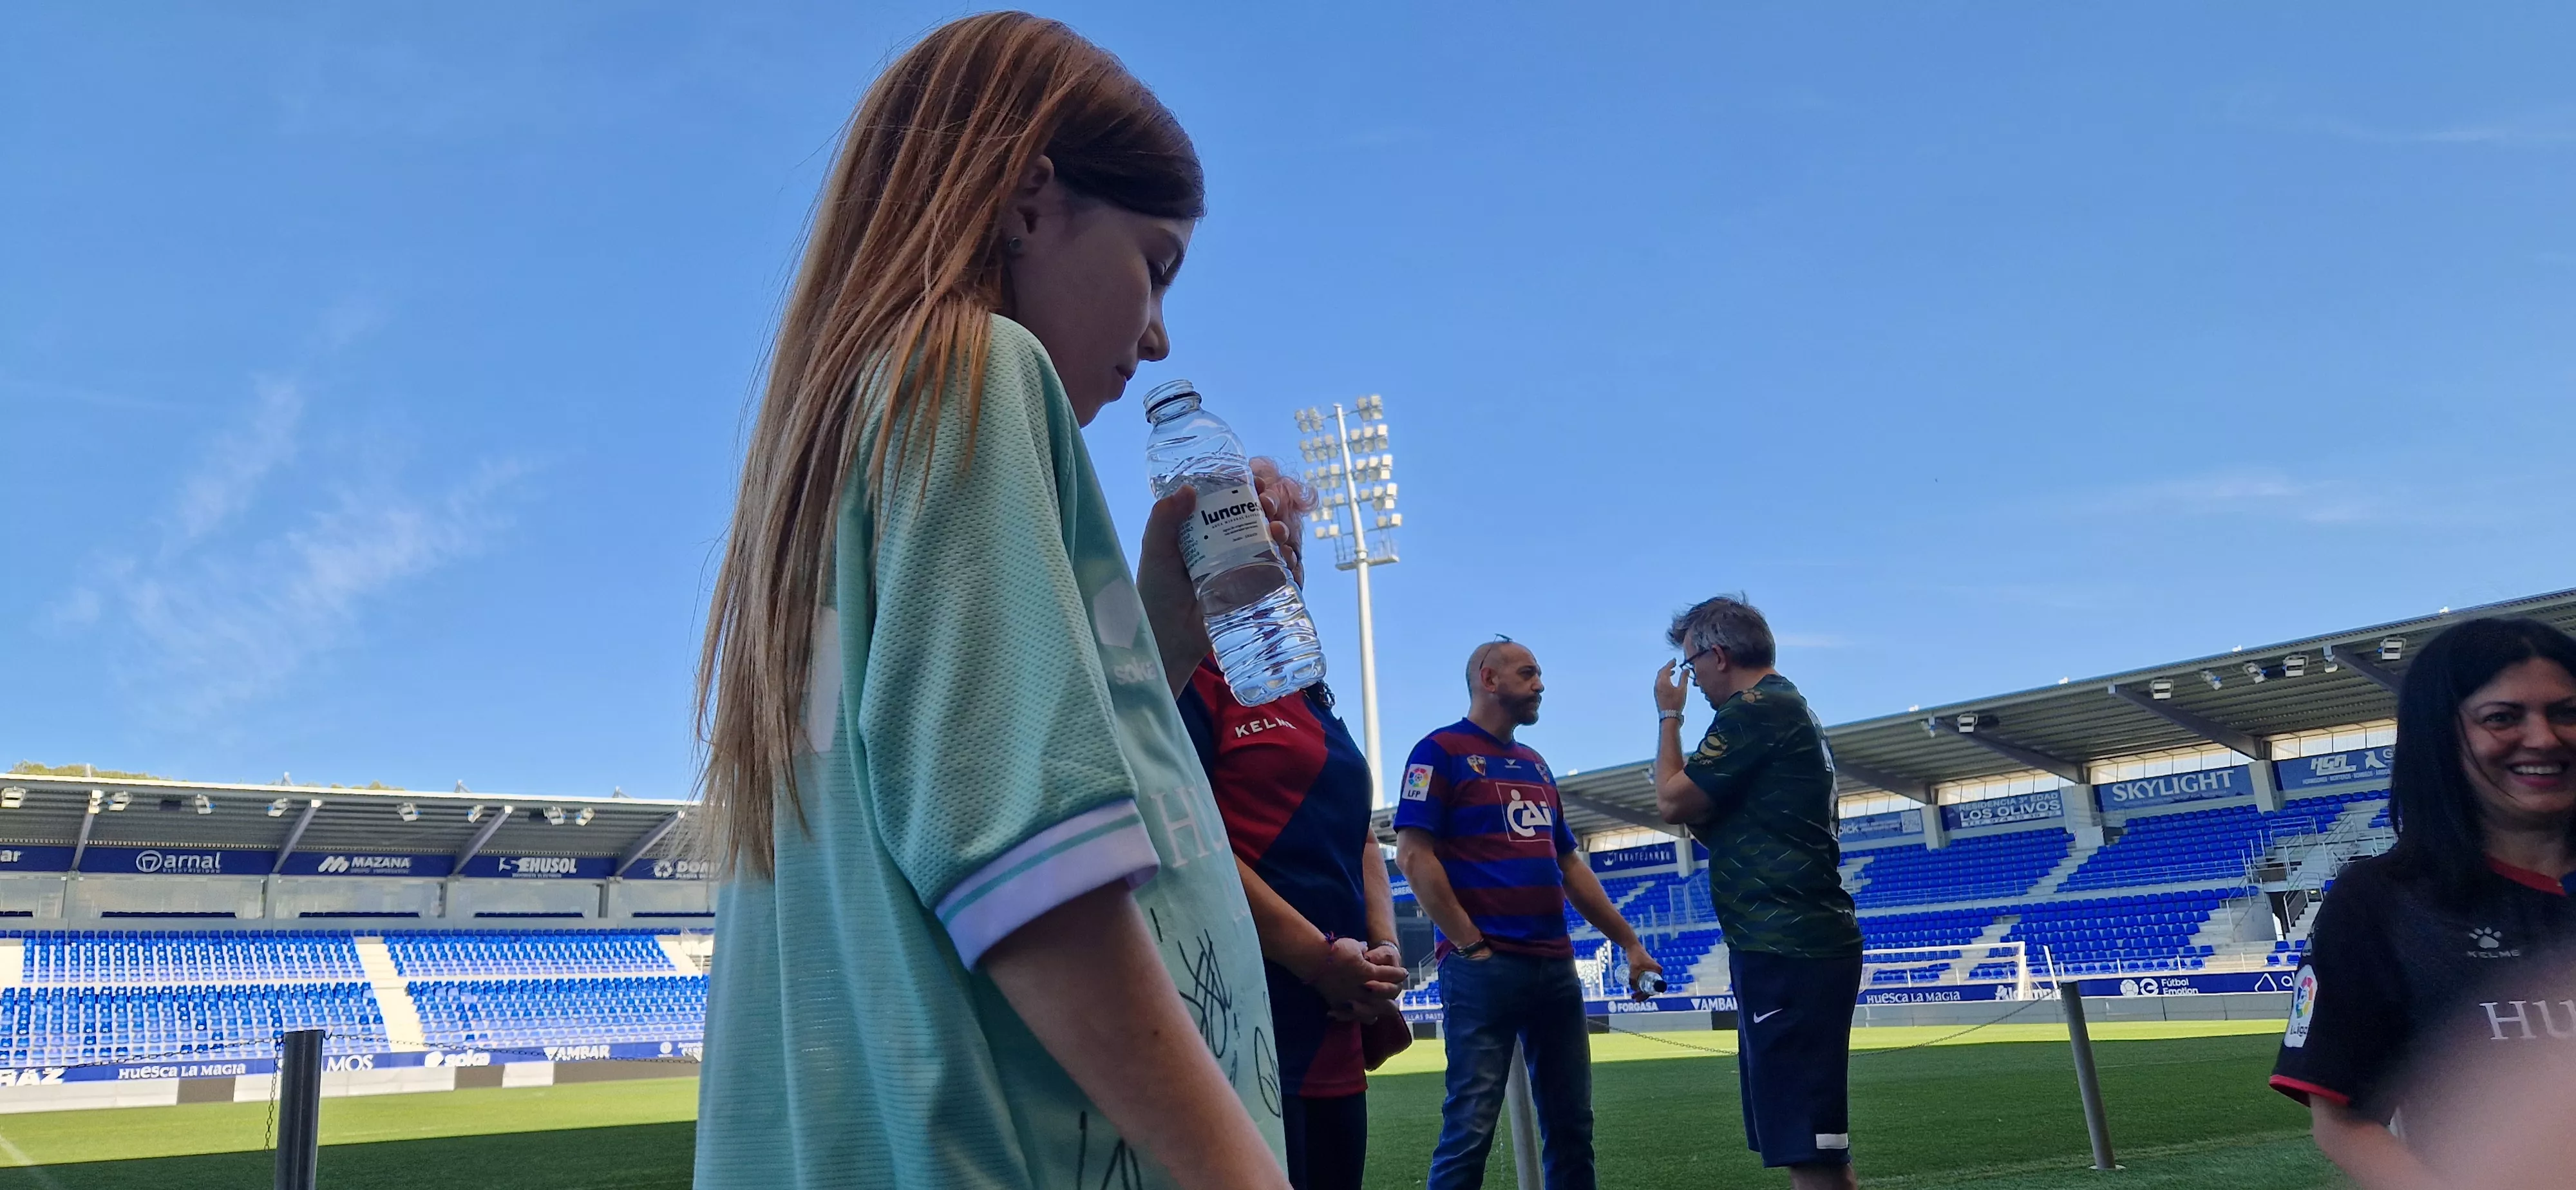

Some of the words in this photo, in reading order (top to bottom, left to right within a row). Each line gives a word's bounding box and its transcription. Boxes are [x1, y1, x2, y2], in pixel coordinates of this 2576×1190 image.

[2112, 770, 2235, 802] SKYLIGHT
[1407, 789, 1421, 798] LFP
[1958, 798, 2016, 811] RESIDENCIA
[2030, 793, 2058, 802] EDAD
[1960, 808, 1993, 822] LOS
[1997, 800, 2061, 817] OLIVOS
[164, 851, 221, 869] arnal
[351, 856, 411, 868] MAZANA
[2467, 950, 2521, 958] KELME
[2161, 977, 2189, 987] Fútbol
[2163, 987, 2199, 995] Emotion
[1617, 1001, 1659, 1012] FORGASA
[557, 1044, 611, 1061] AMBAR
